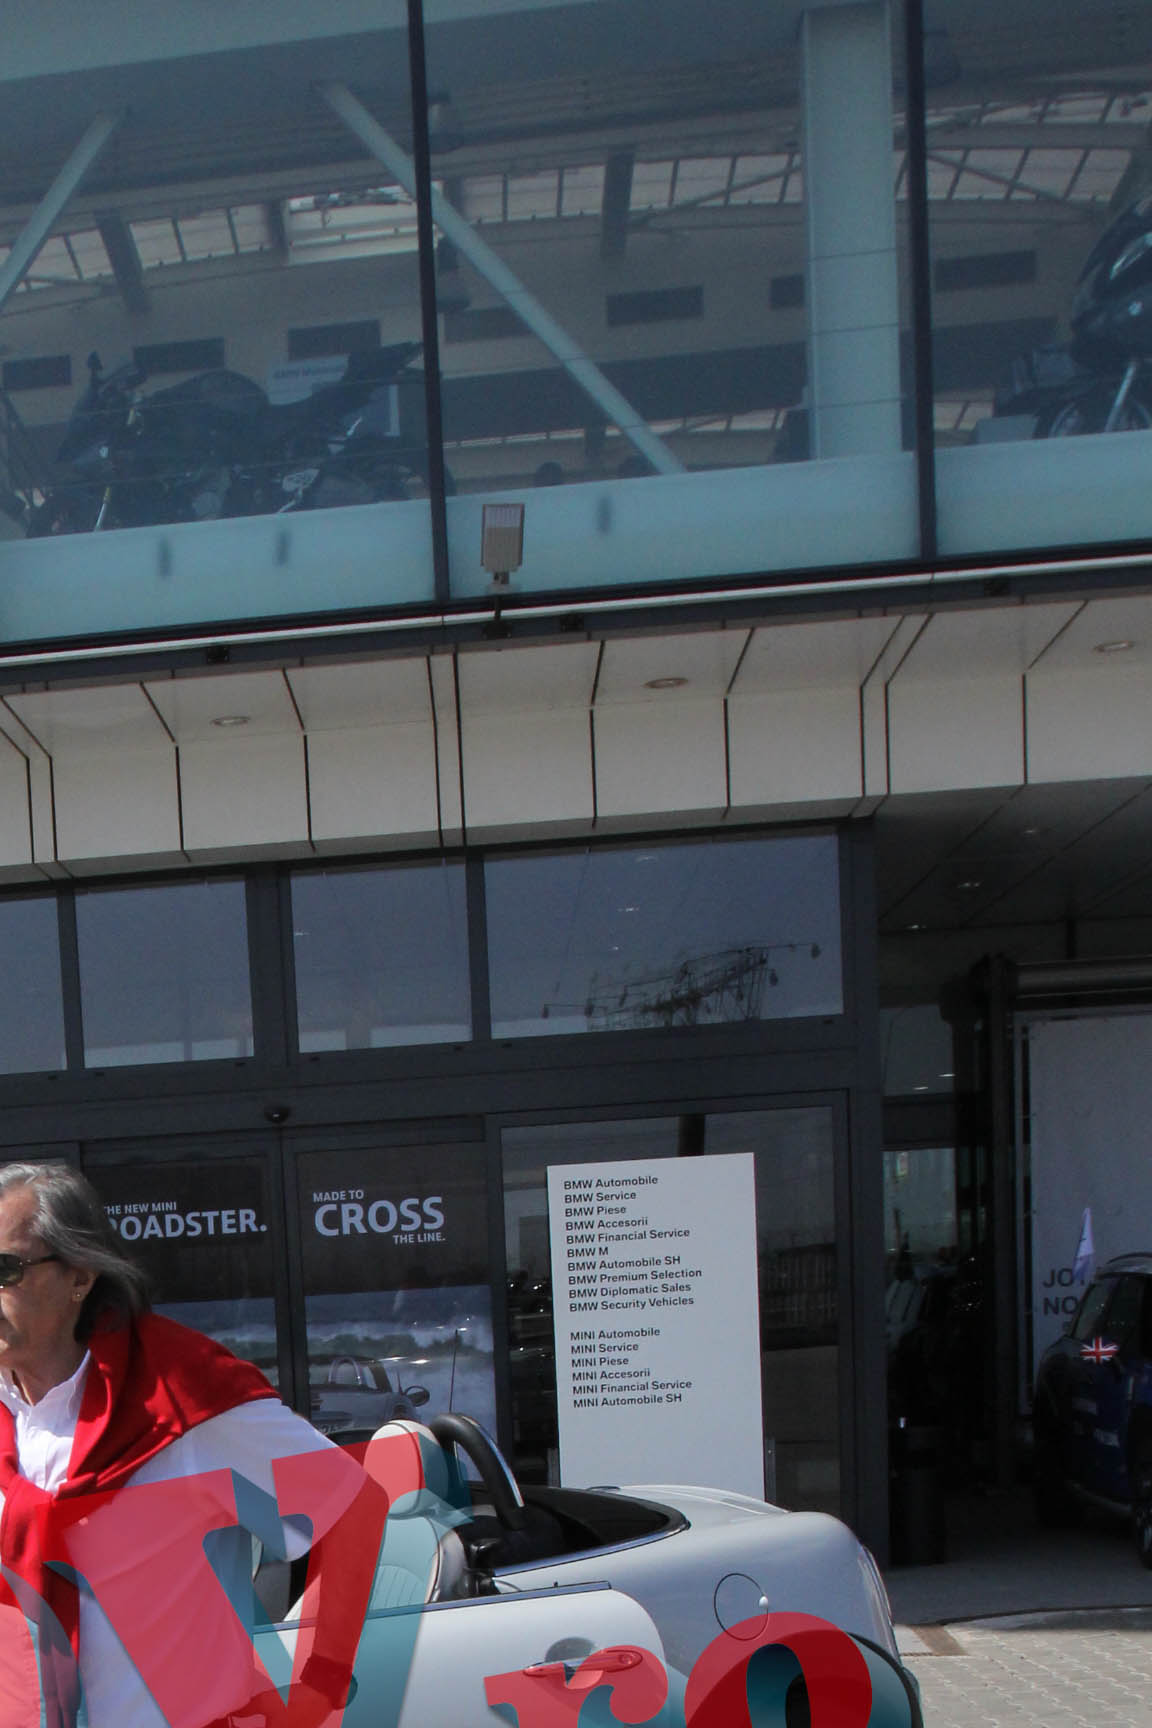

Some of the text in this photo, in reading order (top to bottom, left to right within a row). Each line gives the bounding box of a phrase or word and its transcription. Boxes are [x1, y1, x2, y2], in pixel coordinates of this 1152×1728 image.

[564, 1176, 658, 1190] BMW Automobile
[313, 1190, 364, 1202] MADE TO
[564, 1190, 636, 1204] BMW Service
[124, 1203, 148, 1214] NEW
[152, 1202, 176, 1212] MINI
[565, 1205, 626, 1218] BMW Piese
[315, 1197, 444, 1236] CROSS
[107, 1208, 268, 1240] OADSTER.
[565, 1217, 648, 1231] BMW Accesorii
[393, 1232, 446, 1244] THE LINE.
[566, 1228, 690, 1244] BMW Financial Service
[567, 1246, 608, 1258] BMW M
[568, 1256, 680, 1272] BMW Automobile SH
[568, 1269, 702, 1285] BMW Premium Selection
[568, 1282, 692, 1298] BMW Diplomatic Sales
[569, 1296, 694, 1312] BMW Security Vehicles
[570, 1328, 660, 1341] MINI Automobile
[571, 1342, 639, 1354] MINI Service
[572, 1356, 629, 1368] MINI Piese
[572, 1368, 650, 1381] MINI Accesorii
[573, 1379, 692, 1394] MINI Financial Service
[574, 1392, 682, 1408] MINI Automobile SH
